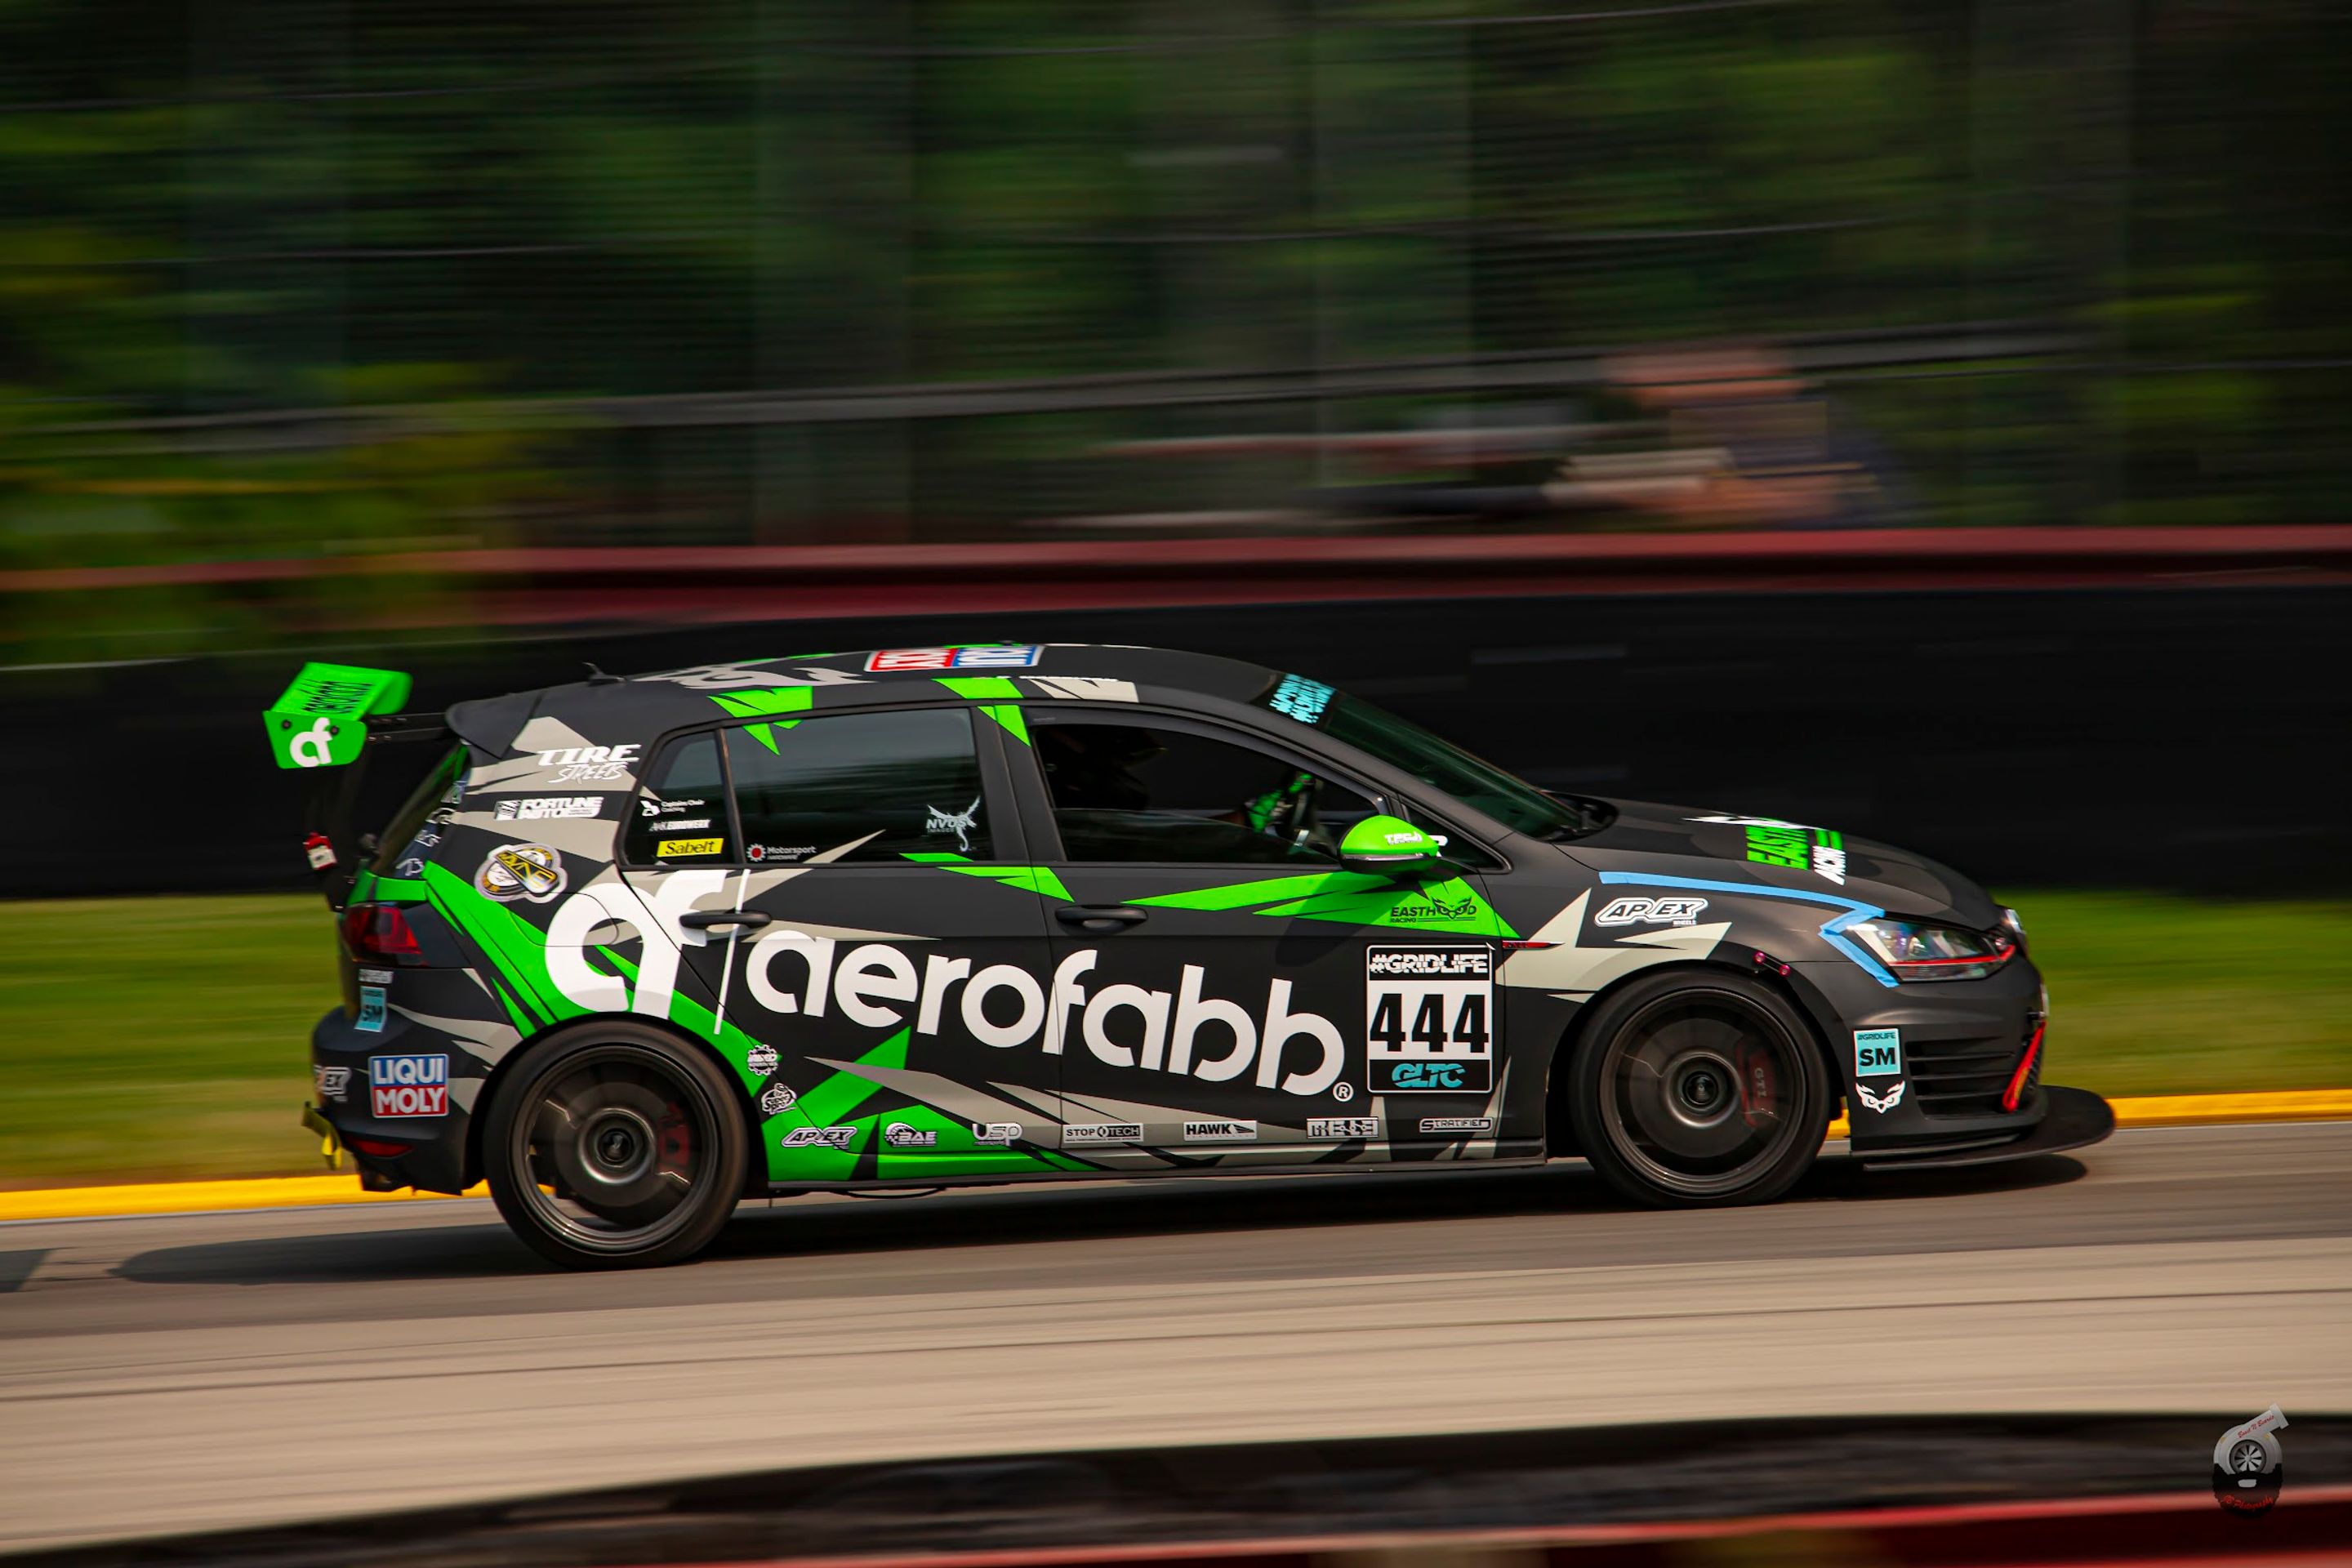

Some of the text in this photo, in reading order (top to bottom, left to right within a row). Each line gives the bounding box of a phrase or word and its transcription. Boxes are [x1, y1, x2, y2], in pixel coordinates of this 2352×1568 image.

[537, 744, 642, 766] TIRE
[547, 762, 629, 784] STREETS
[520, 796, 604, 809] FORTUNE
[517, 808, 564, 820] AUTO
[665, 840, 715, 855] Sabelt
[767, 845, 817, 853] Motorsport
[1601, 900, 1701, 920] APEX
[1370, 953, 1489, 974] #GRIDLIFE
[746, 929, 1345, 1096] aerofabb
[1370, 992, 1490, 1054] 444
[1858, 1031, 1895, 1040] #GRIDLIFE
[1860, 1047, 1896, 1067] SM
[373, 1058, 444, 1085] LIQUI
[1392, 1062, 1467, 1089] GLTC
[1754, 1067, 1767, 1098] GTI
[375, 1087, 446, 1114] MOLY
[1066, 1125, 1140, 1136] STOP TECH
[1186, 1124, 1232, 1134] HAWK
[1421, 1119, 1491, 1130] STRATIFIED
